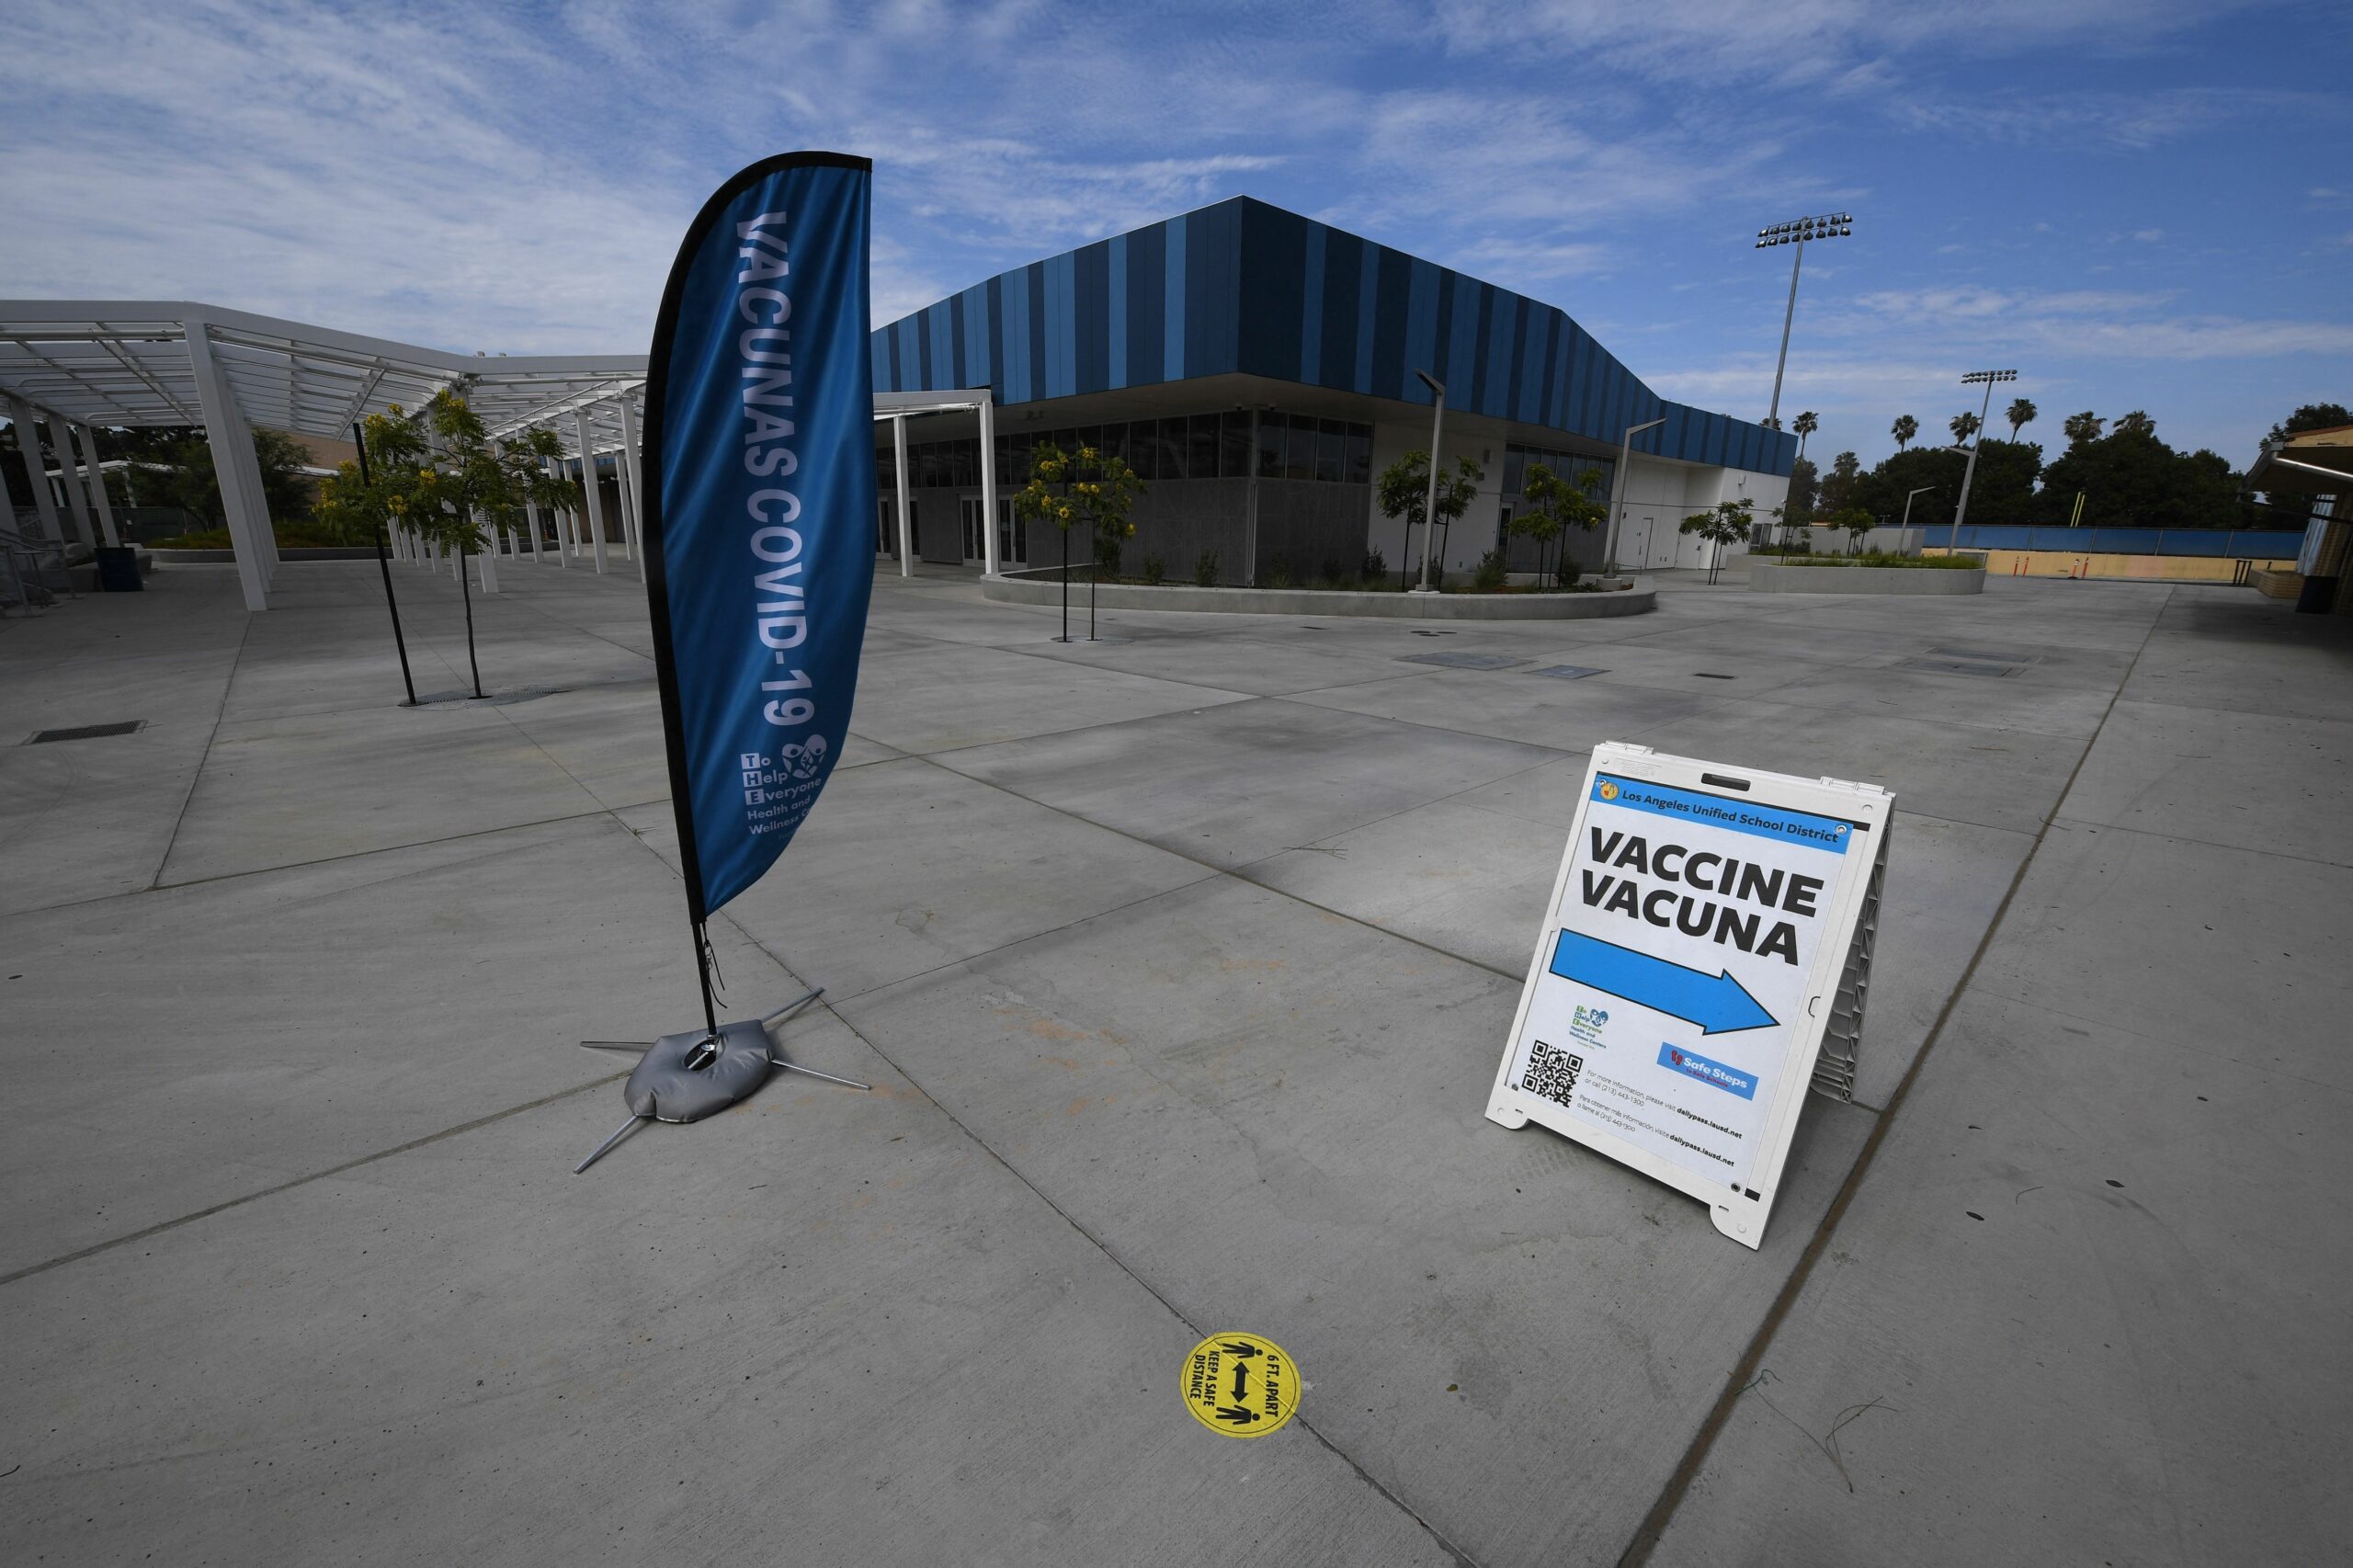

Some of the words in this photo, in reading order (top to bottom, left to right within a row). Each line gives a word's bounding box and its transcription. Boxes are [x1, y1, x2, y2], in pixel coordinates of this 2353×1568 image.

[736, 211, 798, 477] VACUNAS
[747, 489, 815, 726] COVID-19
[741, 753, 771, 769] To
[743, 769, 789, 788] Help
[745, 778, 822, 805] Everyone
[747, 804, 788, 820] Health
[791, 794, 810, 810] and
[1622, 790, 1641, 802] Los
[1643, 794, 1689, 812] Angeles
[1692, 804, 1736, 822] Unified
[1738, 814, 1784, 832] School
[1786, 824, 1838, 844] District
[749, 816, 799, 835] Wellness
[1591, 825, 1824, 918] VACCINE
[1582, 869, 1799, 966] VACUNA
[1684, 1057, 1711, 1074] Safe
[1712, 1068, 1748, 1088] Steps
[1601, 1085, 1617, 1096] (213)
[1597, 1074, 1611, 1085] more
[1646, 1095, 1664, 1107] please
[1665, 1103, 1677, 1112] visit
[1677, 1108, 1743, 1140] dailypass.lausd.net
[1580, 1094, 1591, 1103] Para
[1591, 1100, 1611, 1111] obtener
[1654, 1127, 1669, 1138] visite
[1669, 1134, 1735, 1167] dailypass.lausd.net
[1208, 1350, 1220, 1373] KEEP
[1267, 1364, 1279, 1378] FT.
[1189, 1354, 1206, 1400] DISTANCE
[1206, 1374, 1217, 1382] A
[1203, 1383, 1216, 1406] SAFE
[1265, 1380, 1279, 1417] APART
